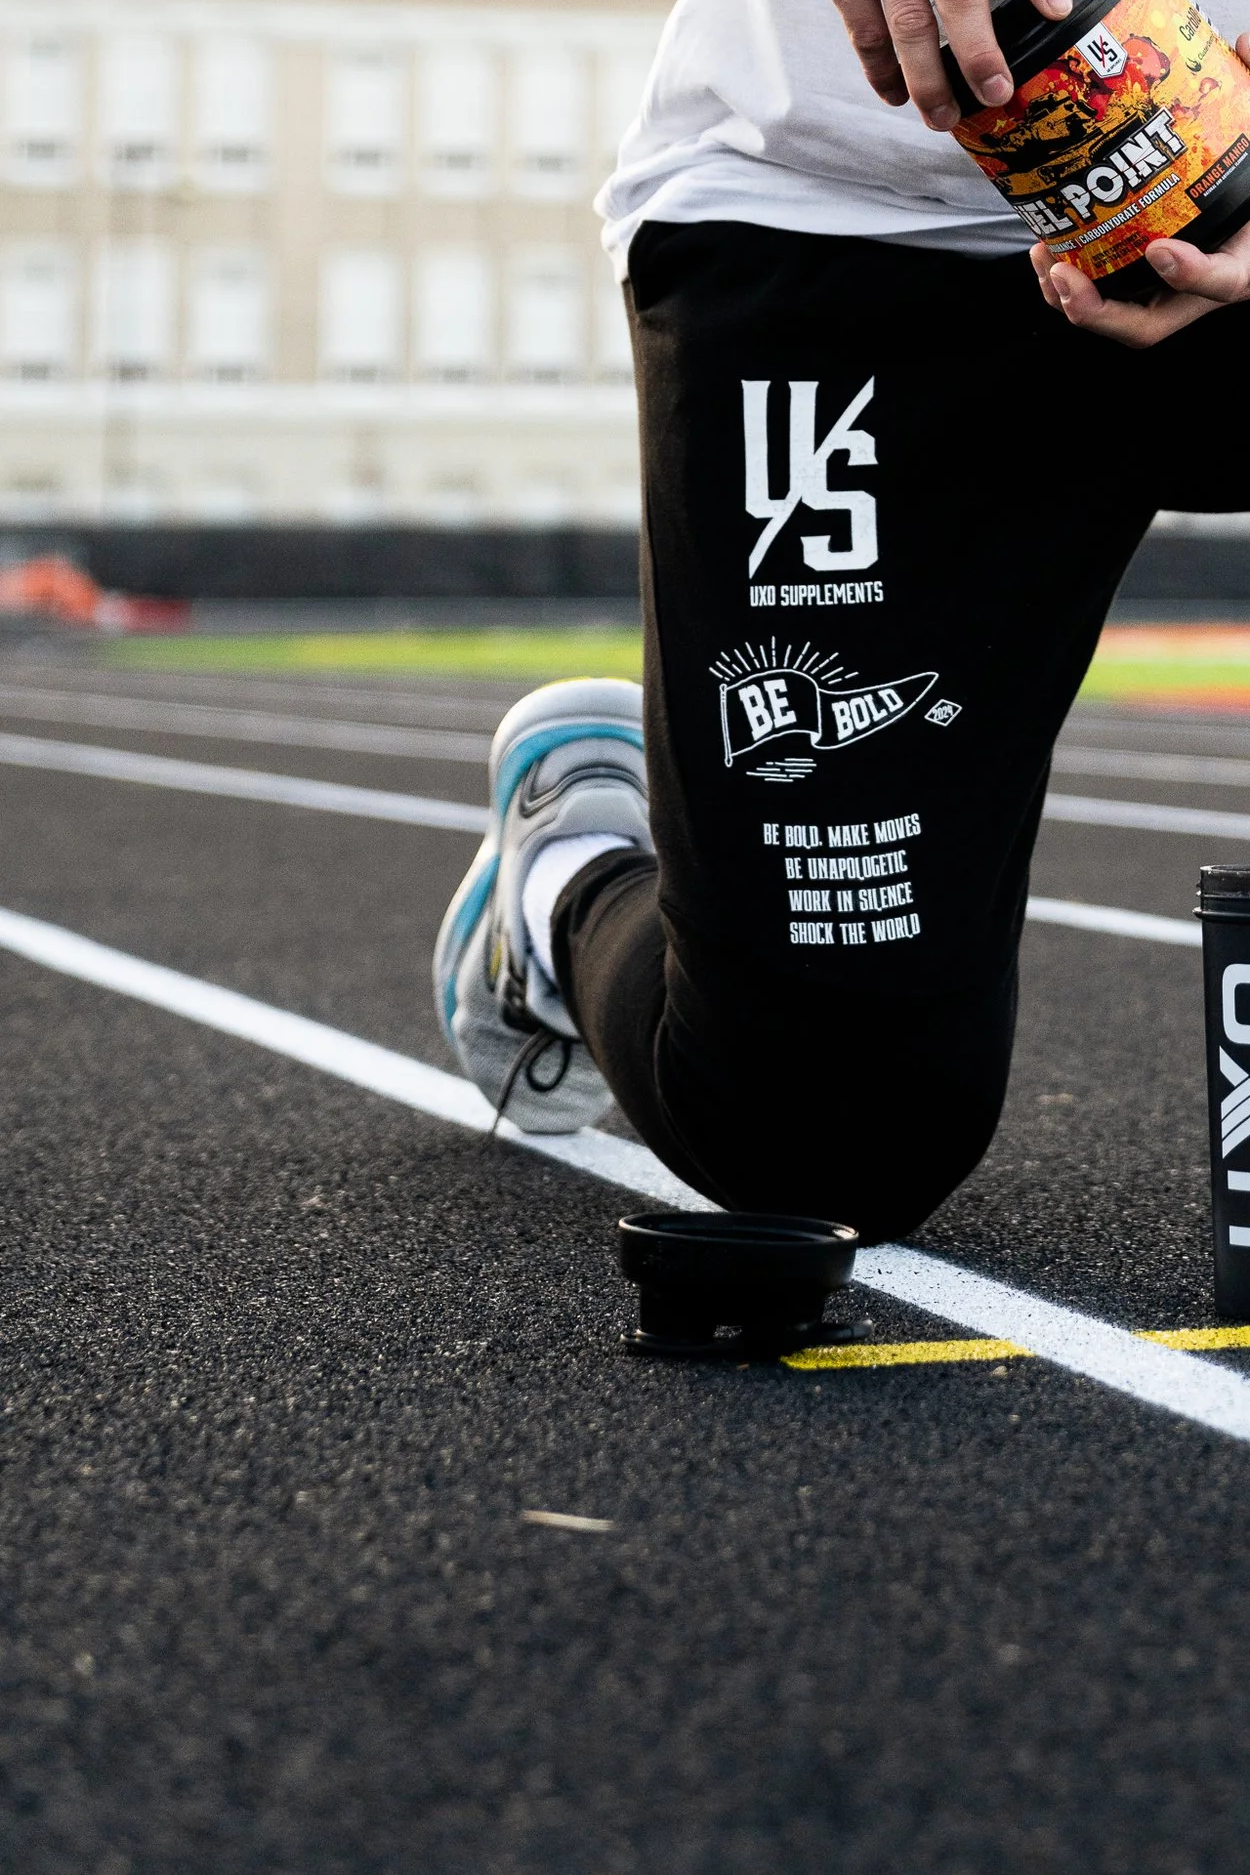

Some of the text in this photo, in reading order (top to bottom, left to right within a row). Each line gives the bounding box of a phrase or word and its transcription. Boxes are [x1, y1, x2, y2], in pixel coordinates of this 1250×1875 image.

[1013, 110, 1186, 235] UEL POINT
[1189, 137, 1249, 198] ORANGE MANGO
[1079, 203, 1141, 245] CARBOHYDRATE
[1139, 172, 1181, 209] FORMULA
[750, 581, 884, 607] UXO SUPPLEMENTS
[738, 678, 904, 741] BE BOLD
[763, 823, 780, 845] BE
[828, 824, 870, 847] MAKE
[874, 813, 921, 844] MOVES
[785, 849, 908, 880] BE UNAPOLOGETIC
[788, 881, 914, 912] WORK IN SILENCE
[790, 913, 921, 945] SHOCK THE WORLD
